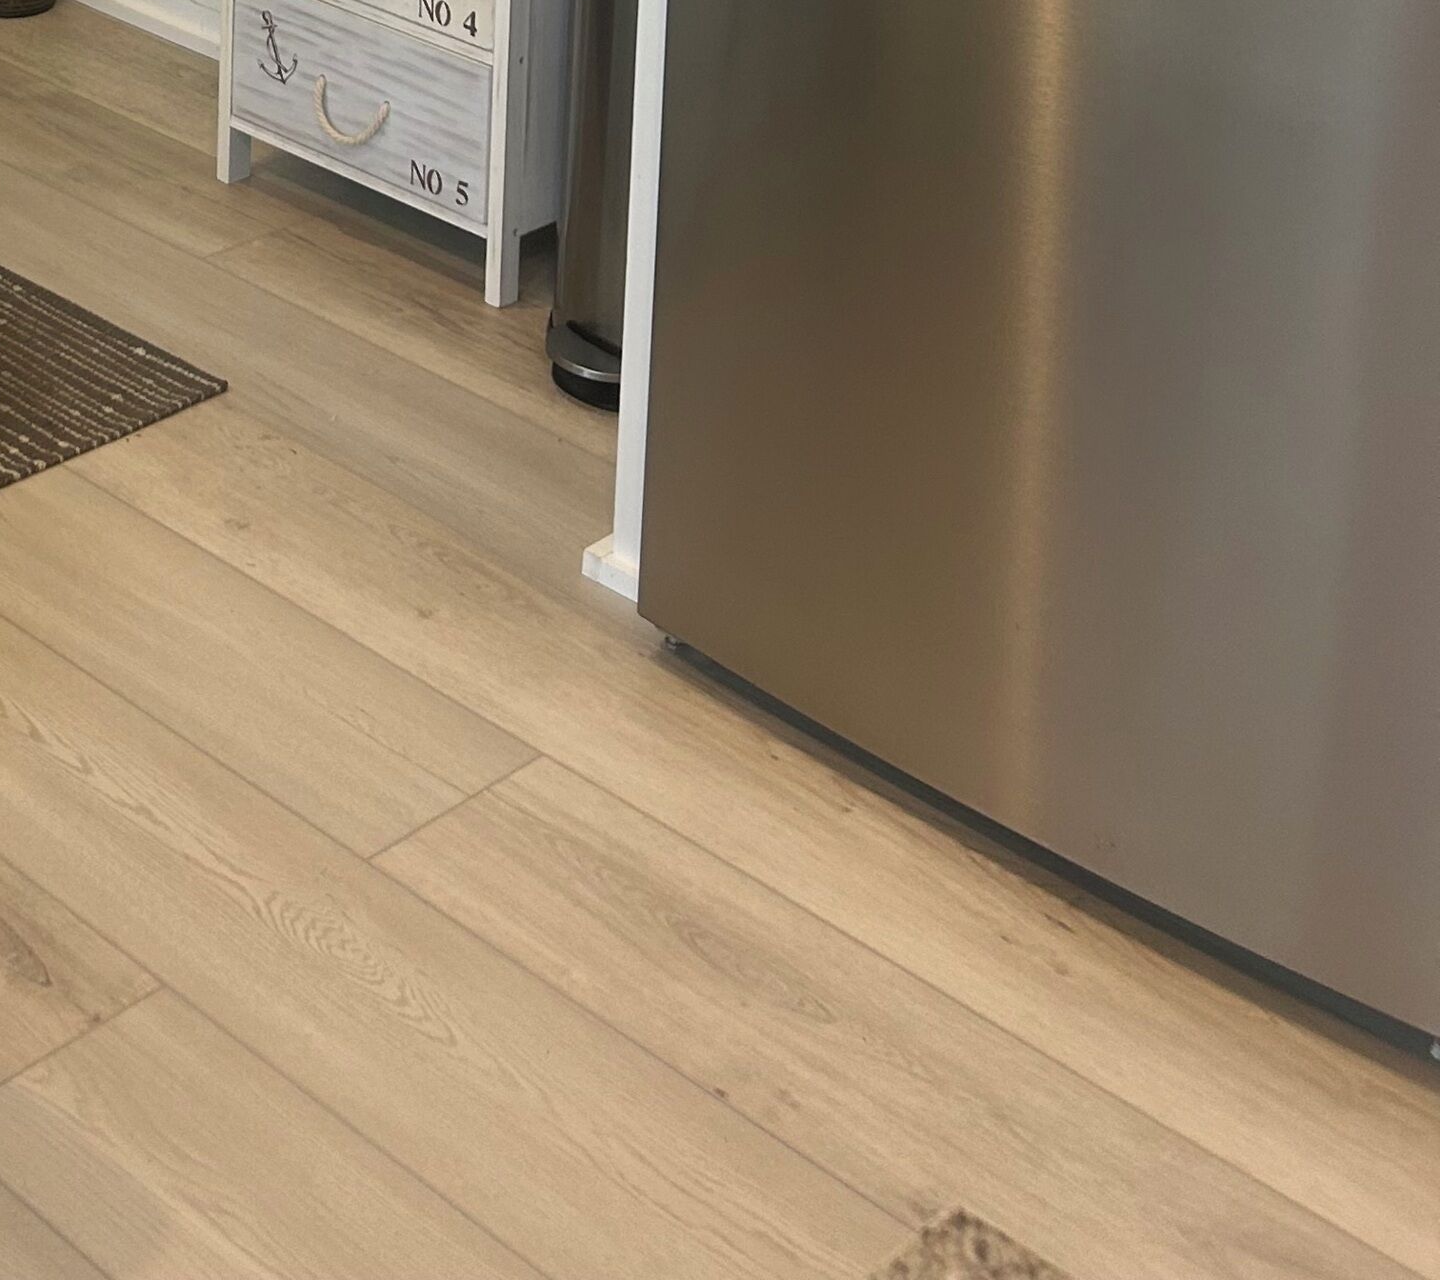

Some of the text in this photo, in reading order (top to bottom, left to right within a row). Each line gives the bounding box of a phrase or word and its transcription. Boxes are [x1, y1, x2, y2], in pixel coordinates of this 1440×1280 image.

[463, 10, 478, 37] 4
[410, 159, 469, 206] NO 5
